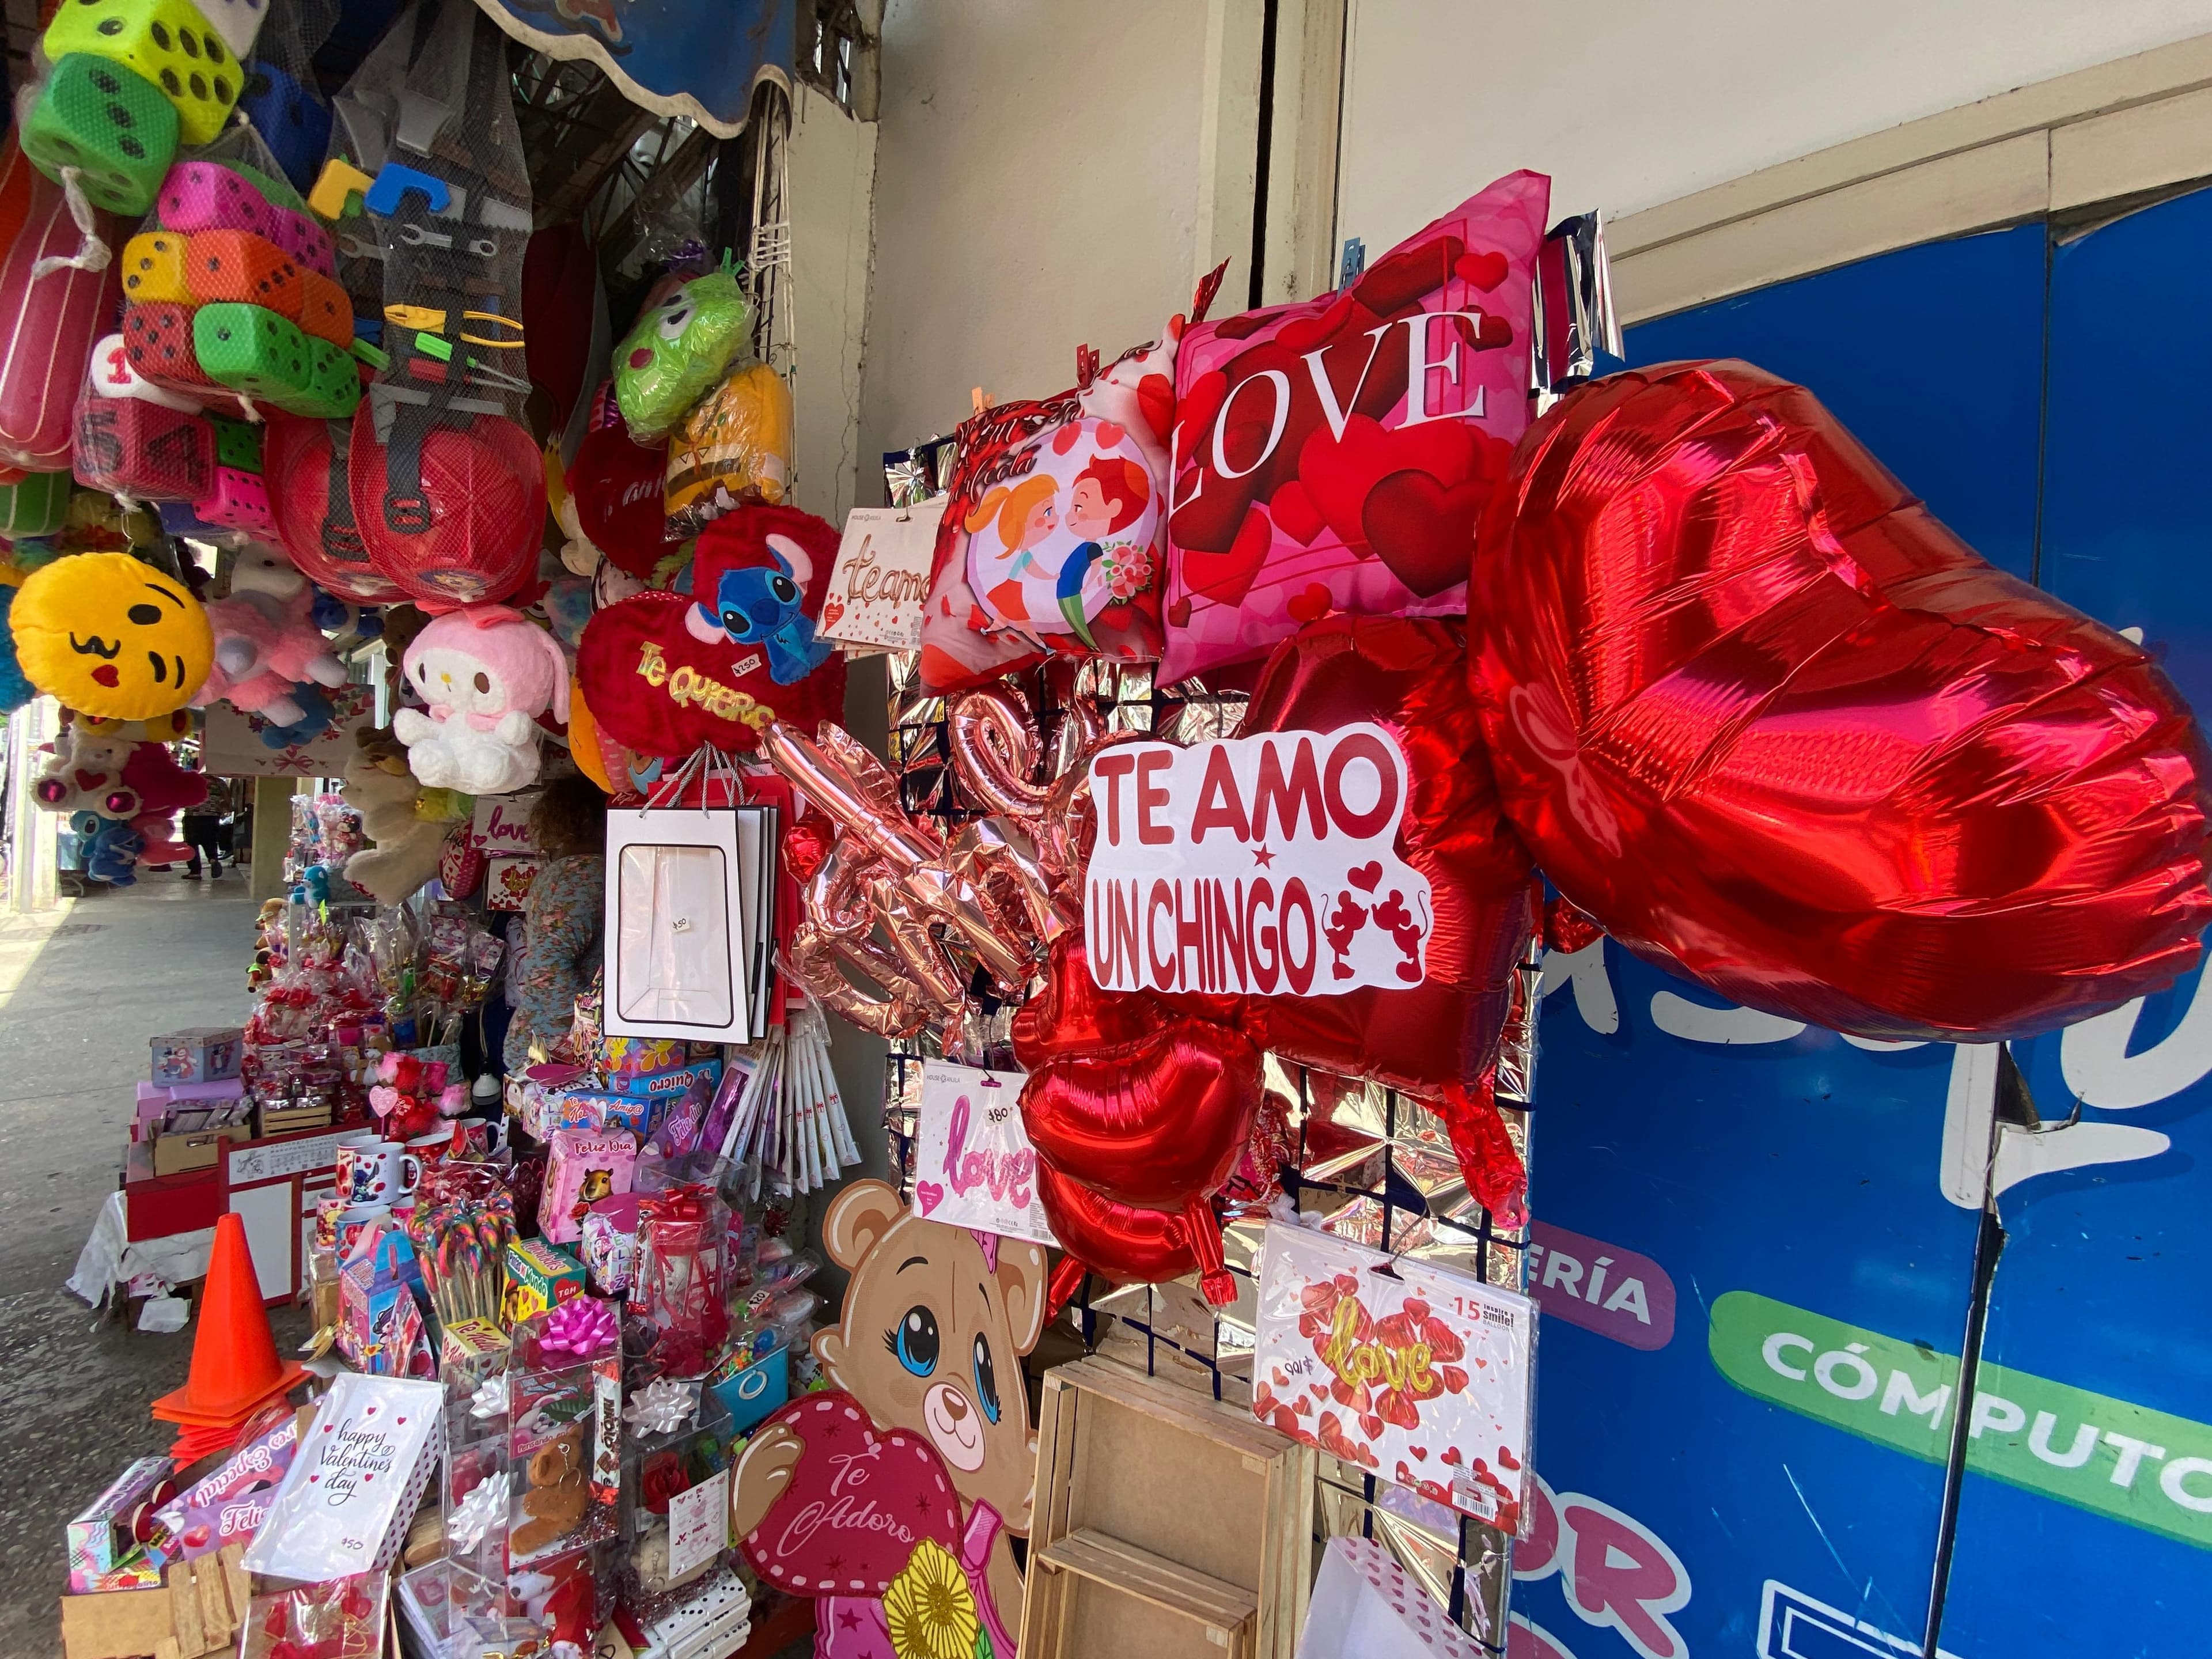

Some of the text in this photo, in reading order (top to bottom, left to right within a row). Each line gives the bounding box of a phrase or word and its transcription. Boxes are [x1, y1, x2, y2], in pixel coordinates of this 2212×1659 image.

[1168, 312, 1484, 516] LOVE
[636, 641, 666, 687] Te
[733, 658, 756, 675] $250
[1094, 733, 1398, 846] TE AMO
[672, 918, 686, 930] $50
[1093, 876, 1316, 995] UN CHINGO
[649, 1071, 694, 1092] Quiero
[608, 1099, 644, 1116] Amig@
[988, 1107, 1008, 1123] $80
[575, 1140, 607, 1155] Feliz
[942, 1094, 1036, 1210] love
[524, 1266, 548, 1297] Mundo
[1454, 1296, 1480, 1321] 15
[1326, 1295, 1434, 1396] love
[338, 1418, 387, 1452] happy
[196, 1446, 272, 1508] Especial
[320, 1444, 396, 1474] Valentine's
[828, 1449, 881, 1497] Te
[324, 1467, 357, 1506] day
[777, 1496, 915, 1558] Adoro
